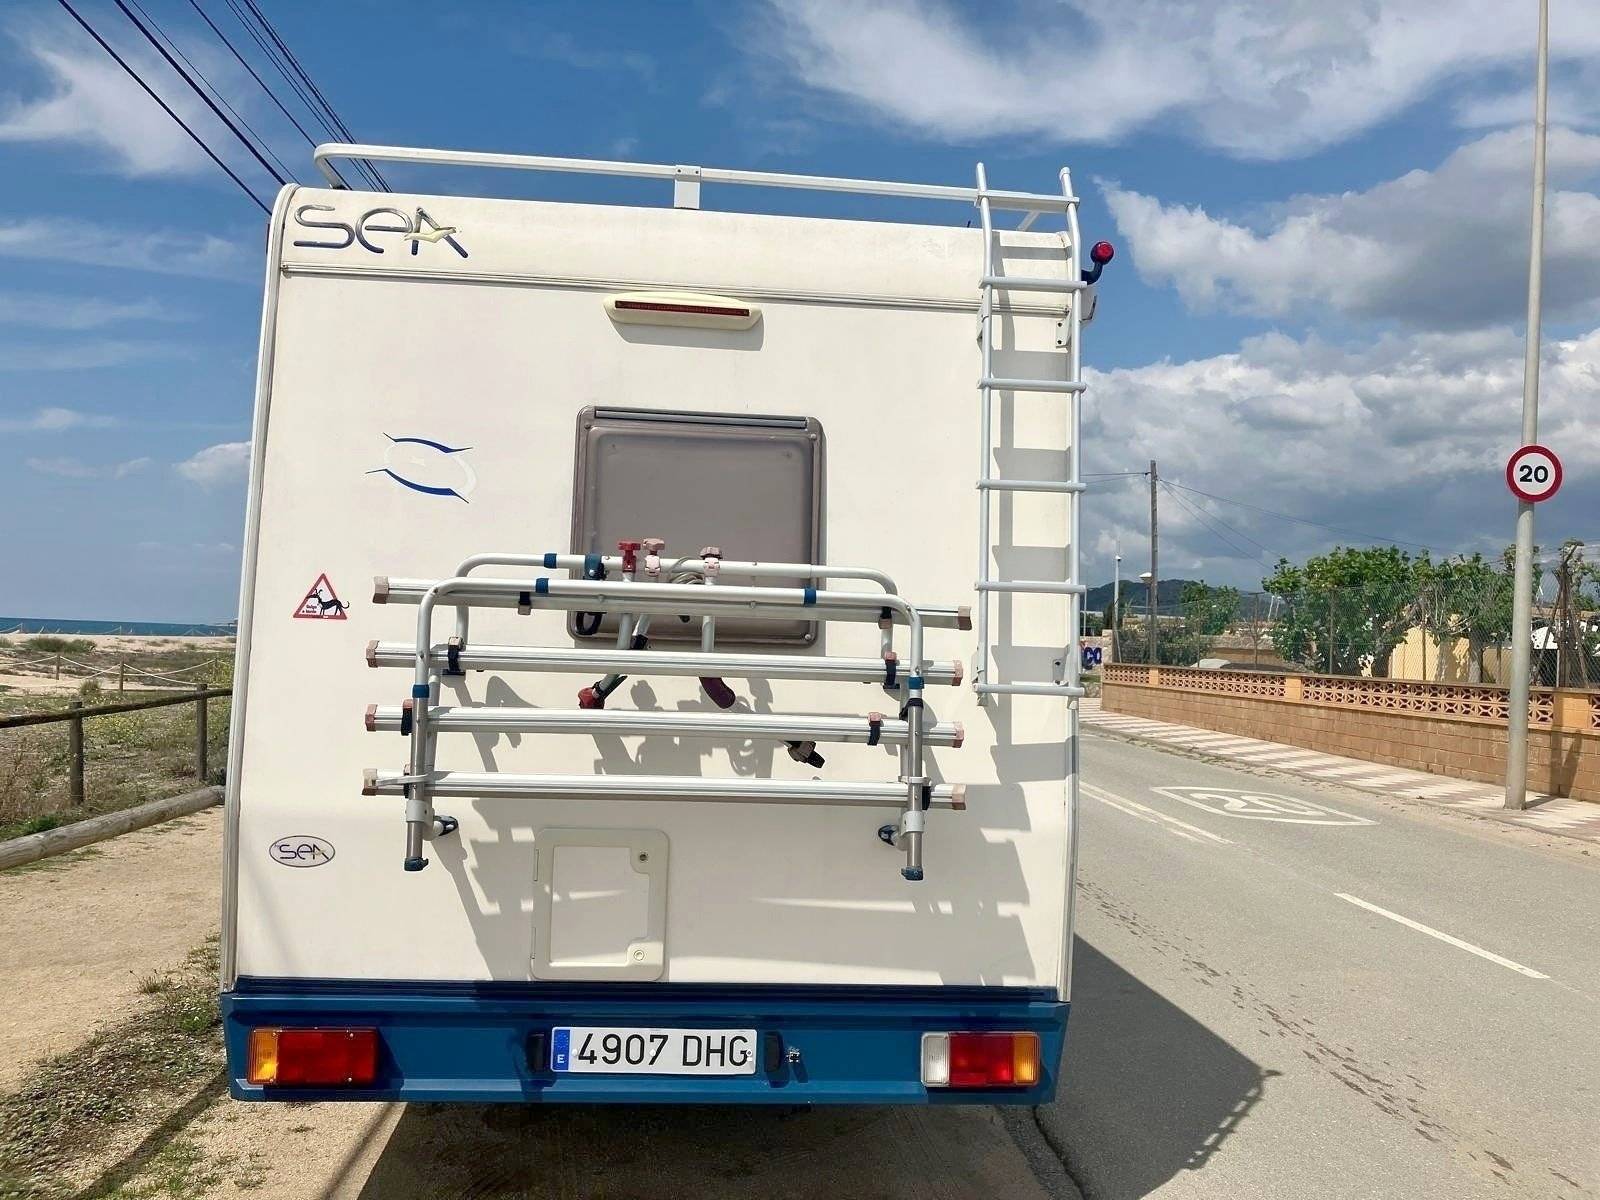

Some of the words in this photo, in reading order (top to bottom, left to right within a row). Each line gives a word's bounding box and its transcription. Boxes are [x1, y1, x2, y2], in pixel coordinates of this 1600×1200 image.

[1519, 464, 1549, 483] 20
[557, 1054, 565, 1064] E
[578, 1033, 669, 1065] 4907
[682, 1035, 748, 1067] DHG
